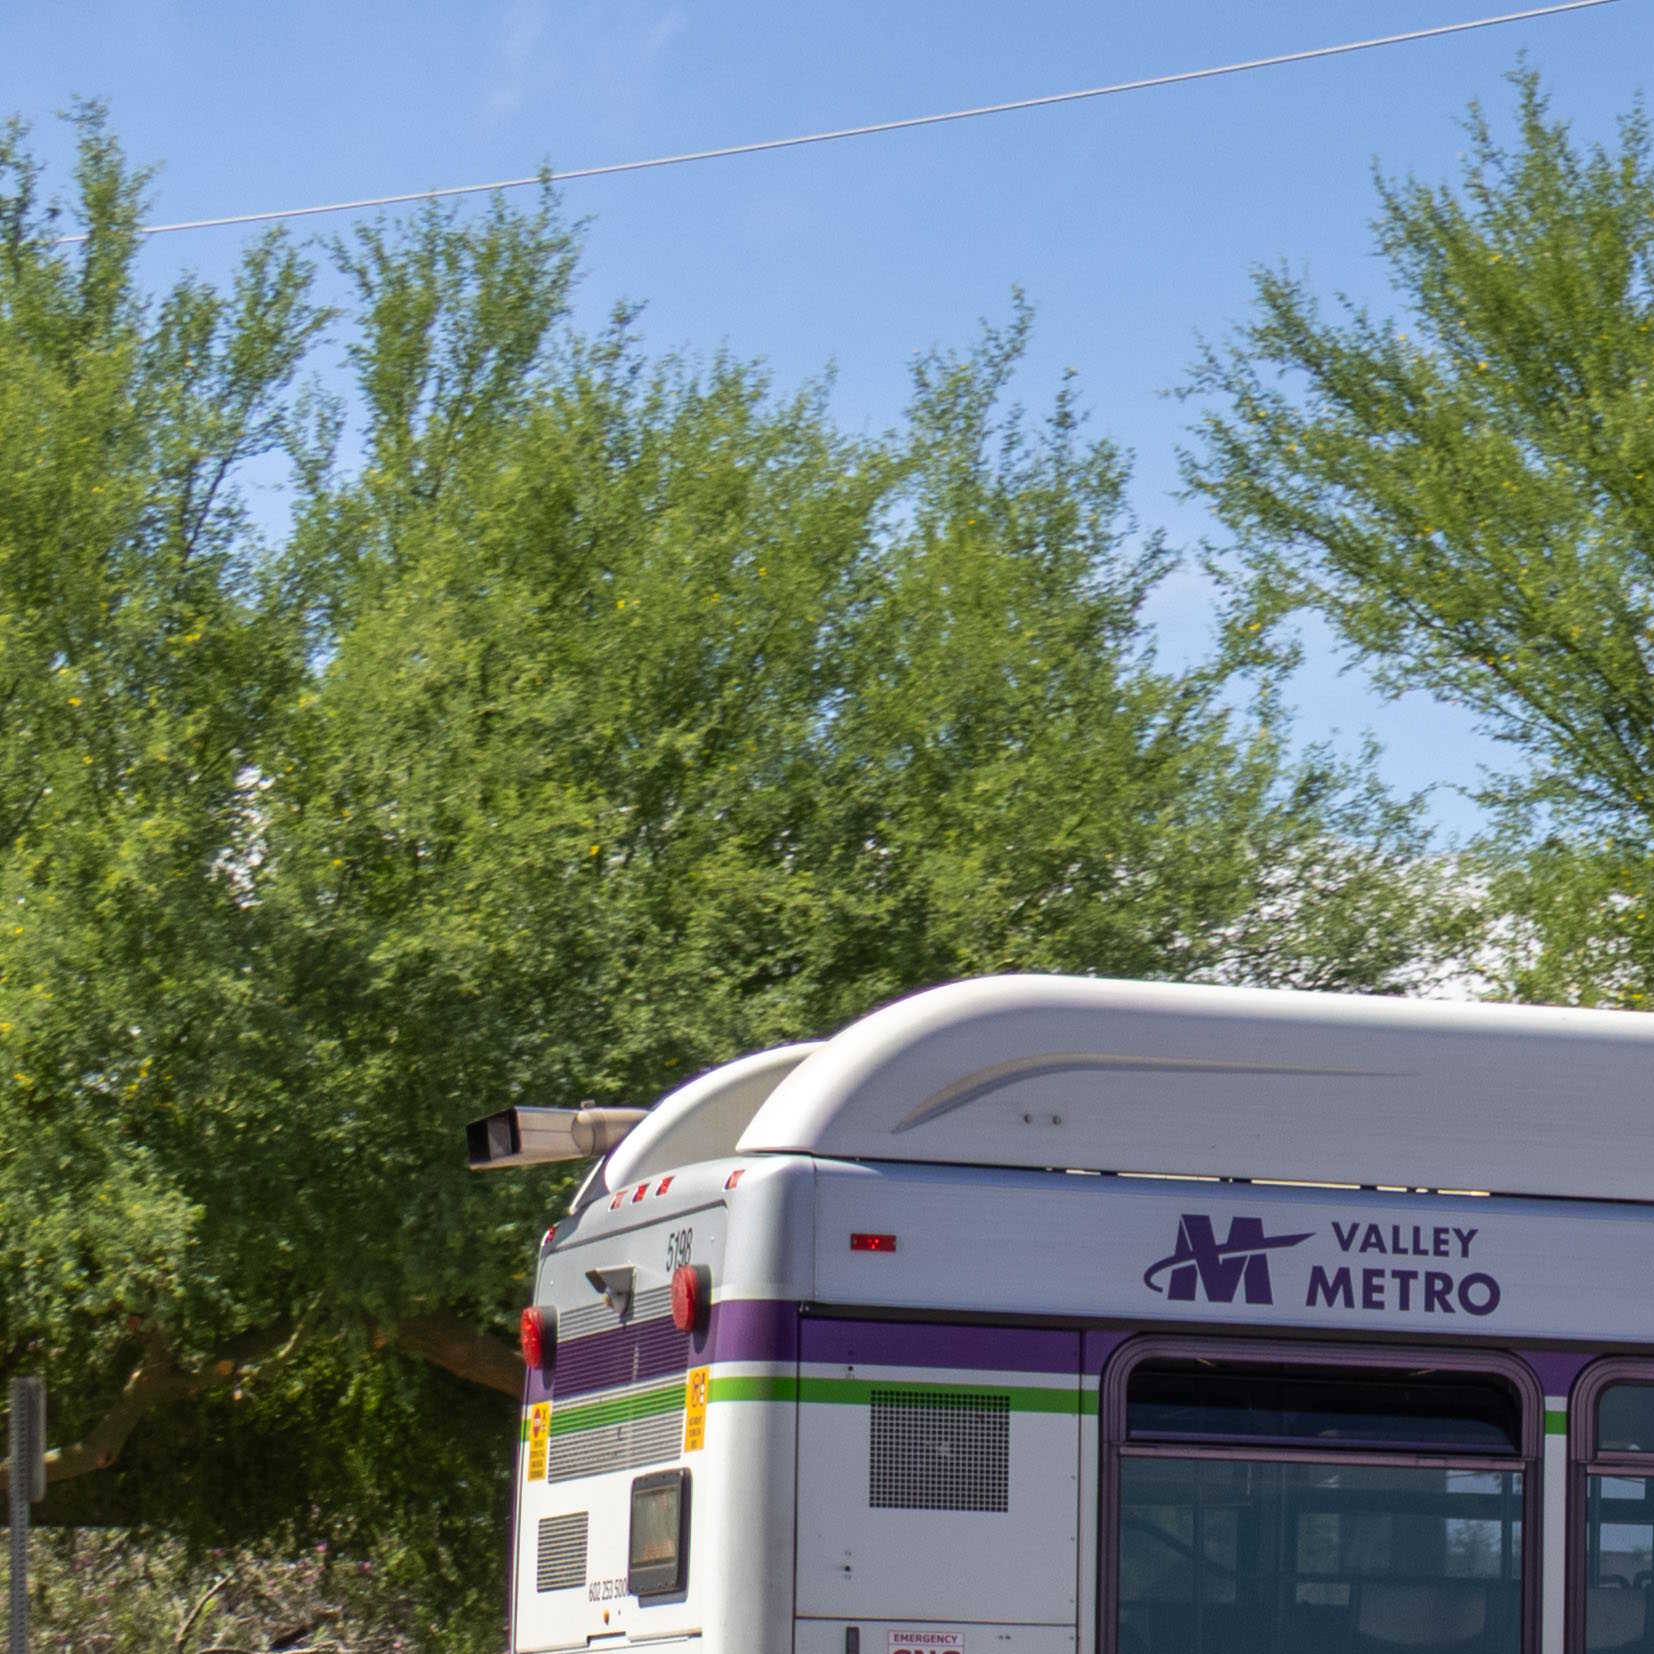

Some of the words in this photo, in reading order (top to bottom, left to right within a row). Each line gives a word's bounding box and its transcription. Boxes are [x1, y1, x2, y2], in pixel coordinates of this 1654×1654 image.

[666, 1227, 693, 1272] 5198
[1331, 1221, 1479, 1258] VALLEY
[1305, 1265, 1501, 1316] METRO
[588, 1581, 601, 1602] 602
[893, 1633, 958, 1644] EMERGENCY
